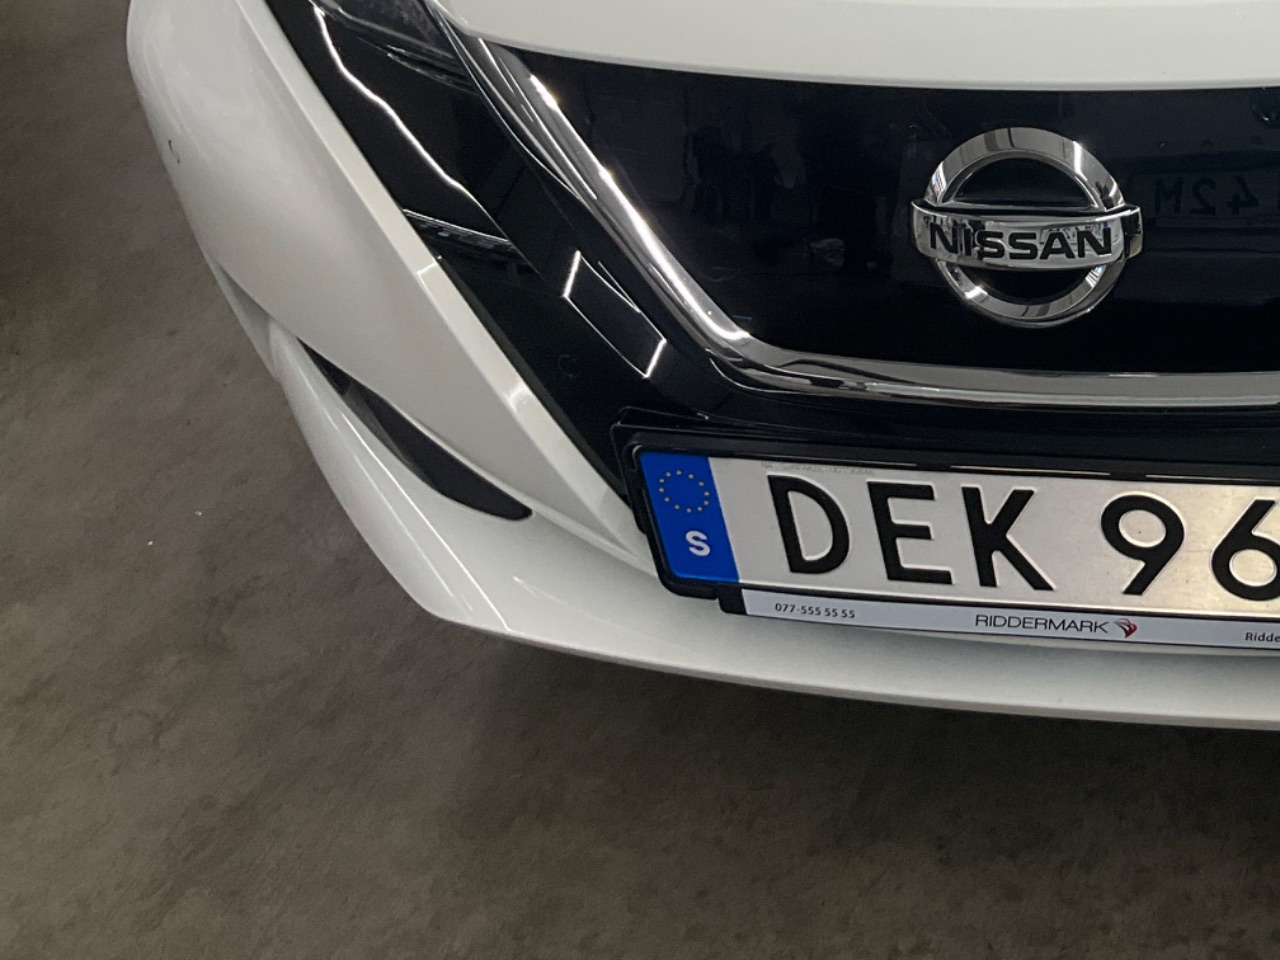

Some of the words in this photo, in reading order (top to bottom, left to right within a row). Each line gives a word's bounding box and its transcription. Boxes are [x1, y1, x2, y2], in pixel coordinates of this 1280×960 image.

[929, 221, 1112, 260] NISSAN
[685, 529, 711, 557] S
[766, 474, 1056, 591] DEK
[774, 602, 822, 616] 077-555
[824, 606, 838, 618] 55
[841, 608, 856, 619] 55
[975, 614, 1109, 634] RIDDERMARK
